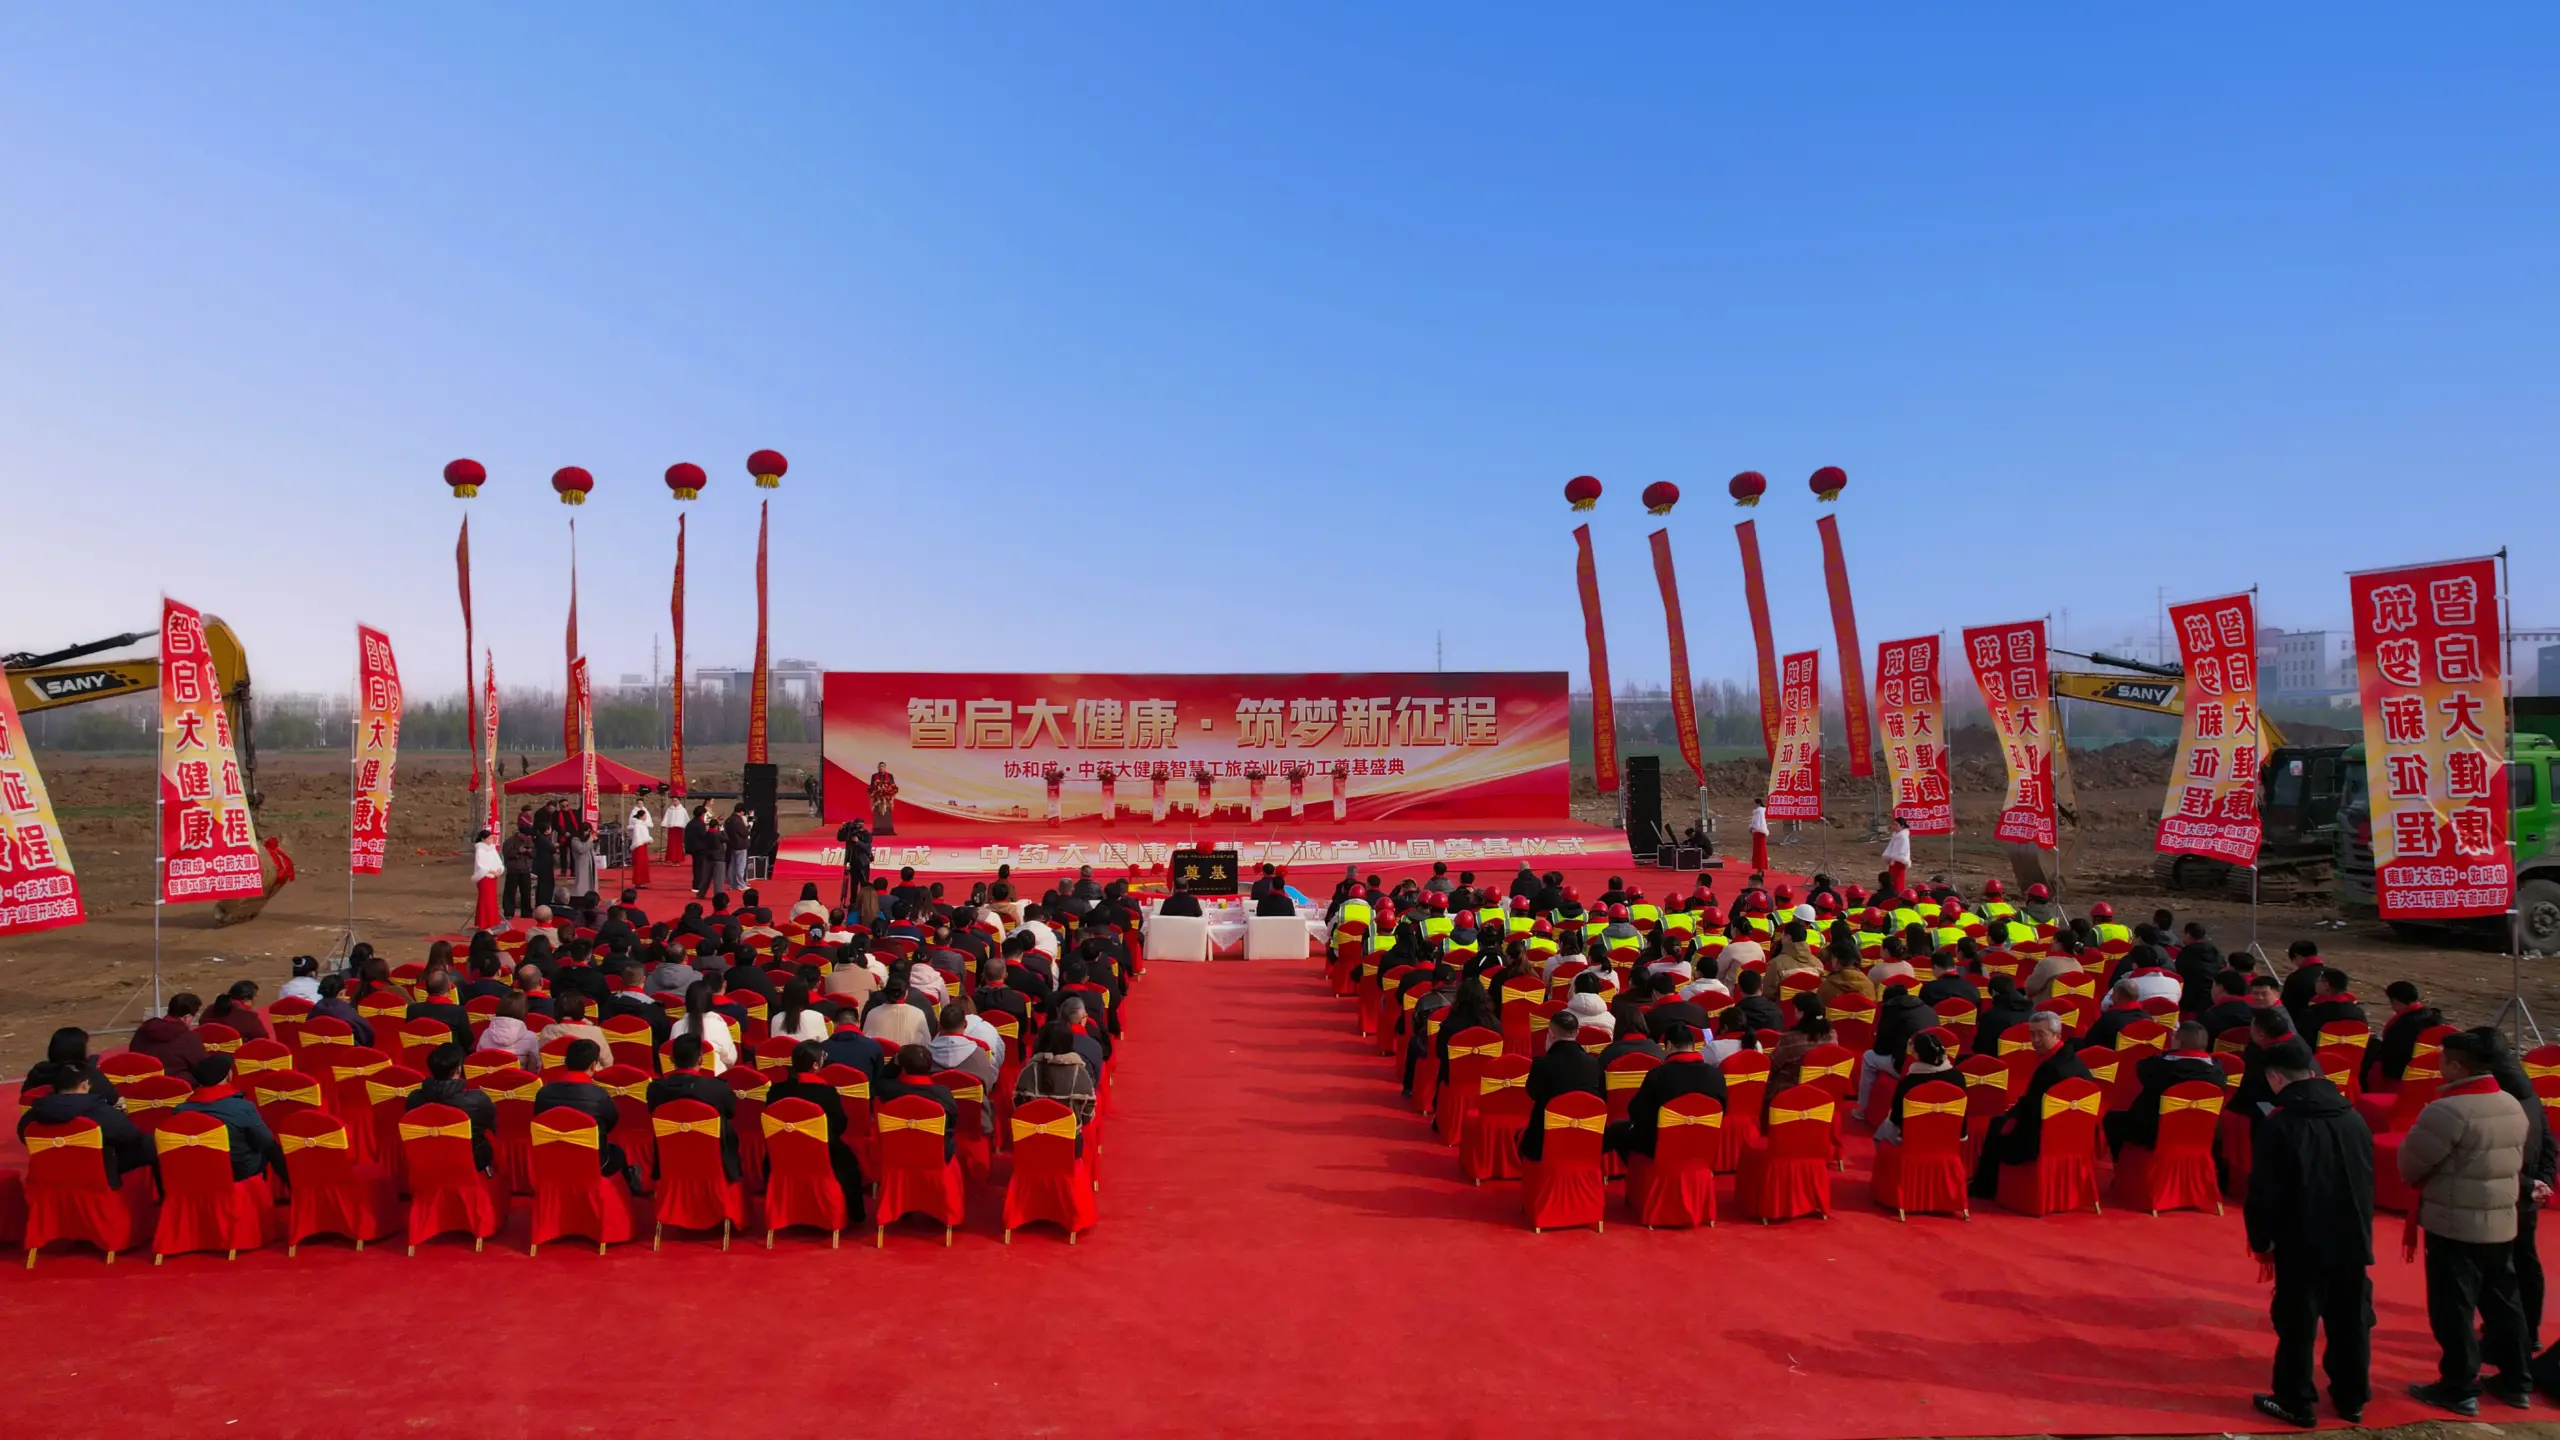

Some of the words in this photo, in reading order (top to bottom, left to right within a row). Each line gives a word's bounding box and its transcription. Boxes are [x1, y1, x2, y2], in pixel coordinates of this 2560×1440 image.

[46, 671, 106, 696] SANY
[2117, 685, 2168, 702] SANY
[168, 610, 213, 850] 智启大健康
[353, 635, 388, 831] 智启大健康
[907, 696, 1499, 749] 智启大健康·筑梦新征程
[1183, 864, 1228, 881] 奠基
